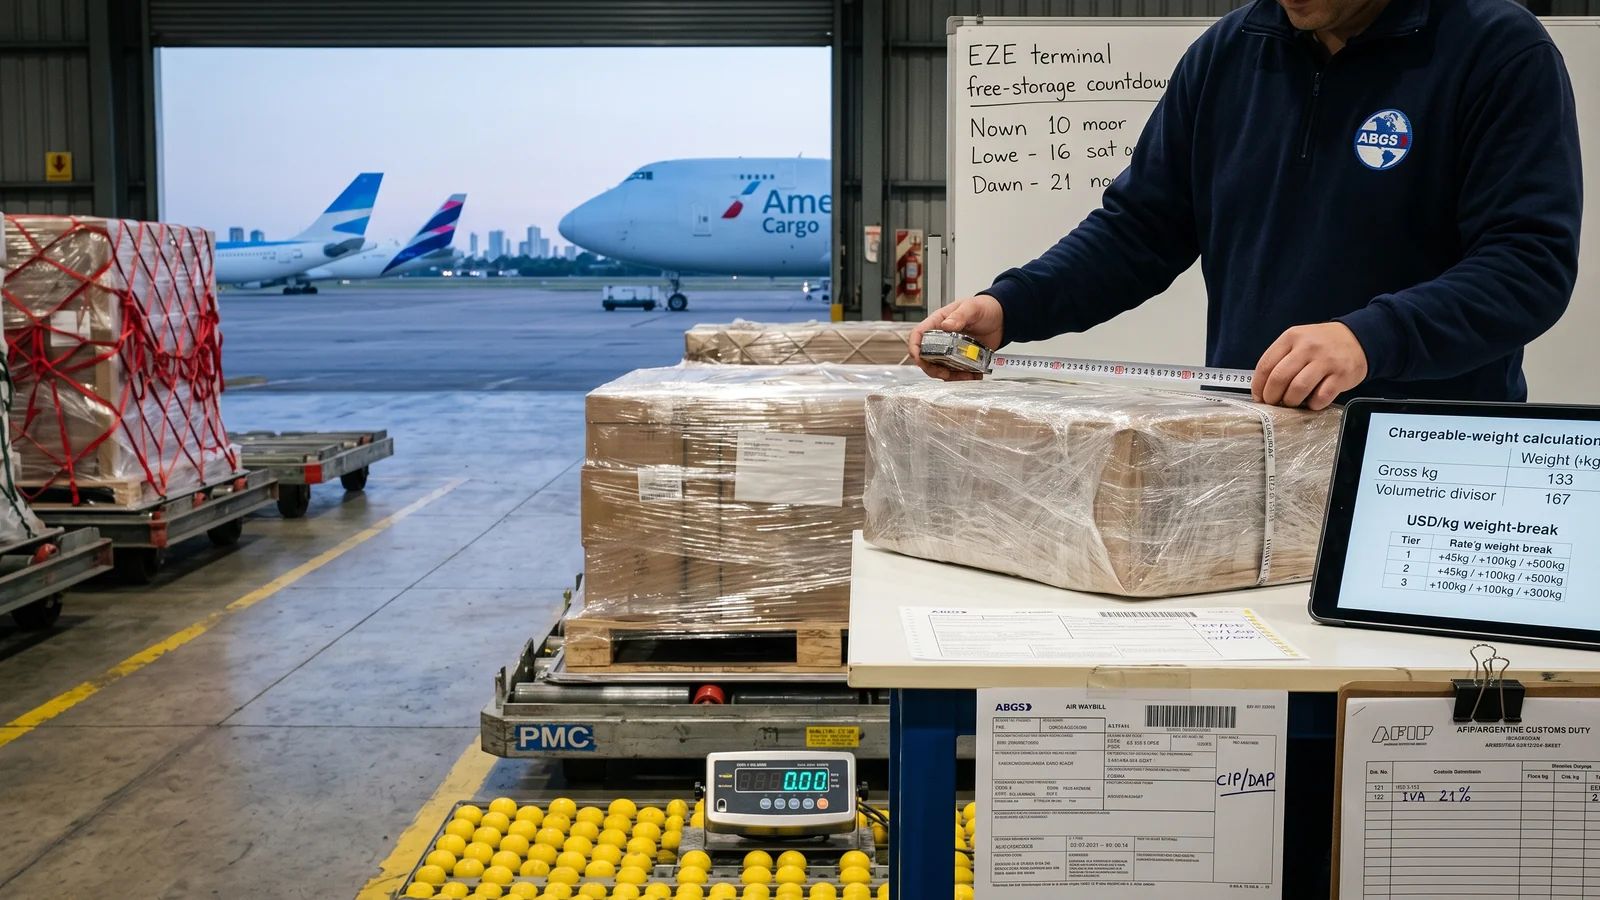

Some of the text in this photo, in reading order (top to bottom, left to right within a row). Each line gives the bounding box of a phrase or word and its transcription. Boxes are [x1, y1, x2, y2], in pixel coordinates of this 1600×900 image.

[969, 43, 1112, 66] EZE terminal
[967, 75, 1076, 101] free-storage
[970, 115, 1127, 138] Nown 10 moor
[1358, 132, 1398, 146] ABGS
[972, 146, 1020, 164] Lowe
[1051, 144, 1071, 161] 16
[1086, 140, 1118, 159] sat
[972, 175, 1023, 195] Dawn
[1051, 173, 1071, 191] 21
[763, 217, 819, 238] Cargo
[1388, 427, 1519, 445] Chargeable-weight
[1521, 452, 1570, 467] Weight
[1378, 465, 1573, 485] Gross kg 133
[1376, 484, 1571, 505] Volumetric divisor 167
[1407, 514, 1558, 536] USD/kg weight-break
[1401, 535, 1421, 545] Tier
[1484, 542, 1520, 553] weight
[1522, 544, 1552, 554] break
[1439, 554, 1469, 564] +45kg
[1479, 556, 1516, 568] +100kg
[1526, 560, 1565, 571] +500kg
[1403, 564, 1410, 573] 2
[1437, 568, 1468, 579] +45kg
[1477, 570, 1515, 582] +100kg
[1525, 574, 1564, 586] +500kg
[1401, 578, 1408, 587] 3
[1429, 581, 1467, 593] +100kg
[1476, 585, 1514, 597] +100kg
[1523, 589, 1562, 601] +300kg
[995, 703, 1025, 711] ABGS
[519, 726, 591, 748] PMC
[1372, 726, 1434, 743] AFIP
[1457, 726, 1524, 734] AFIP/ARGENTINE
[1526, 726, 1566, 734] CUSTOMS
[1216, 768, 1275, 791] CIP/DAP
[1402, 791, 1425, 802] IVA
